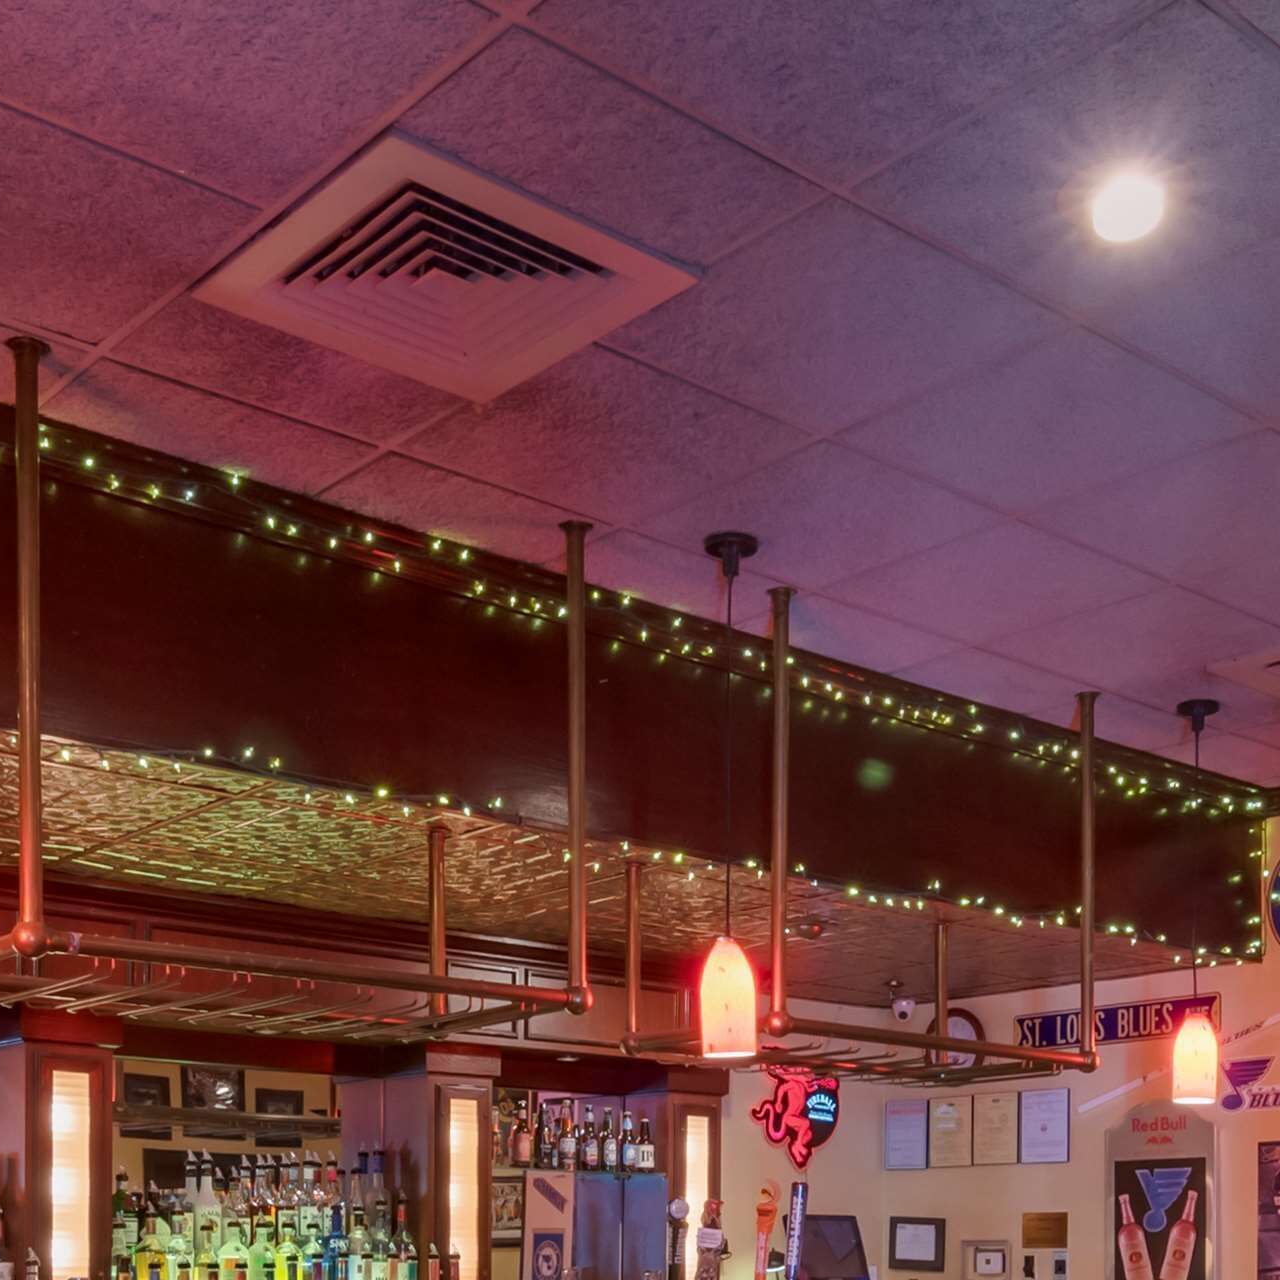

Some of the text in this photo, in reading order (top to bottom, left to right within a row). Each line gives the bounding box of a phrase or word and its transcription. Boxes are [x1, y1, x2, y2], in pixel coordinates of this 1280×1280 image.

[1022, 1018, 1047, 1048] ST.
[1055, 1010, 1105, 1044] LOS
[1116, 1002, 1174, 1038] BLUES
